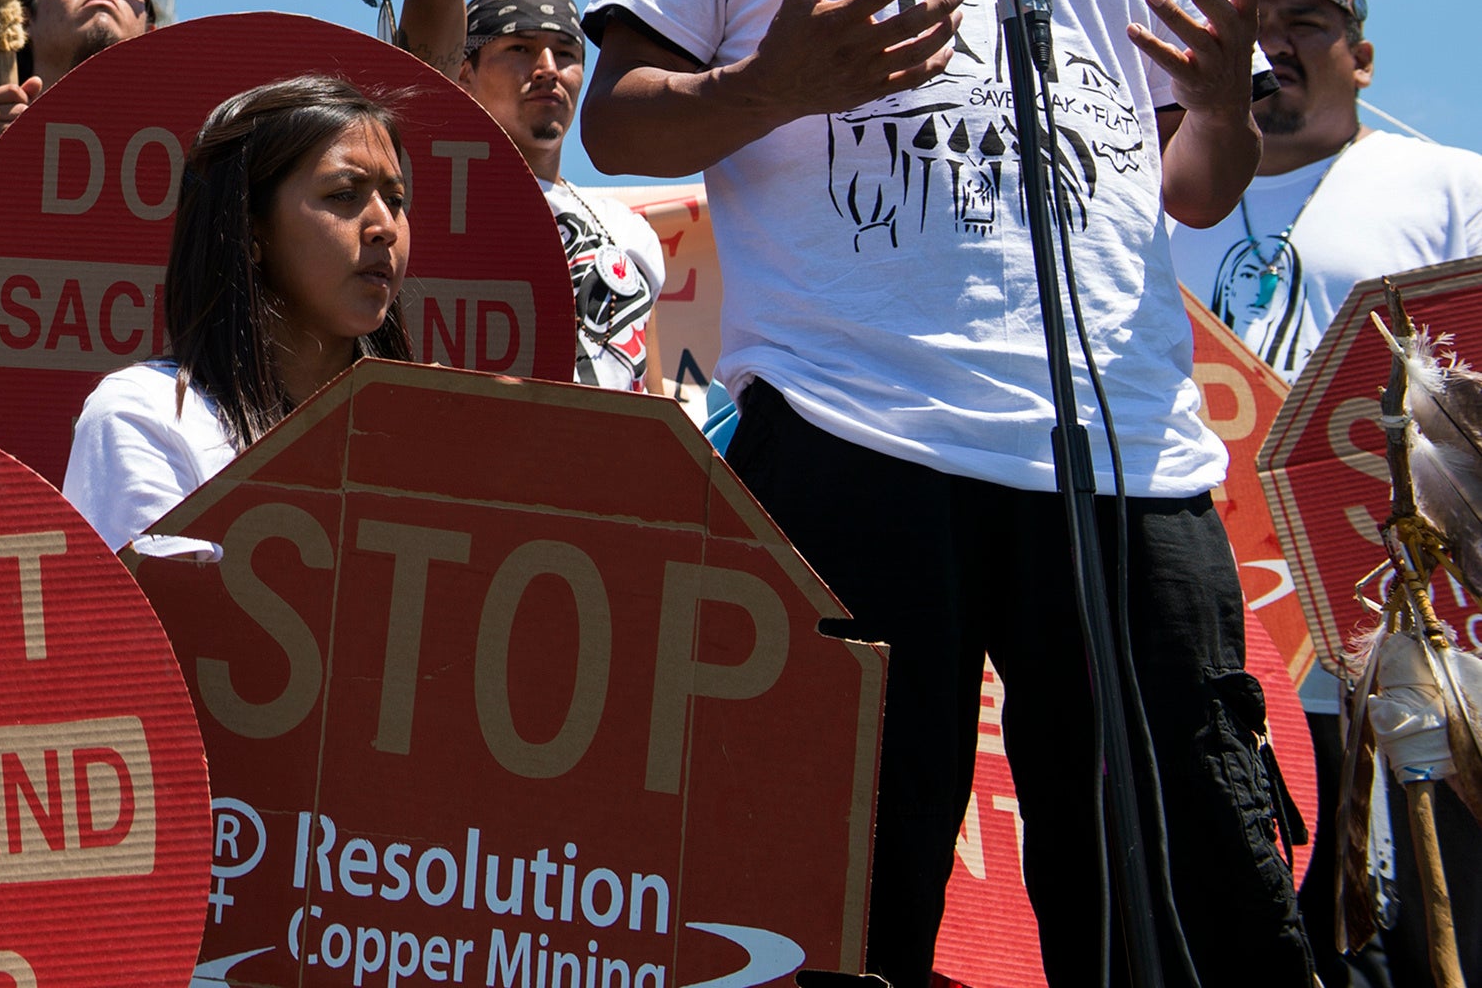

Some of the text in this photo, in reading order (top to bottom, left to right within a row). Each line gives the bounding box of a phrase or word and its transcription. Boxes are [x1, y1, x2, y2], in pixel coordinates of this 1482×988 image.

[969, 87, 1014, 109] SAVE
[1091, 103, 1135, 136] FLAT
[40, 122, 182, 222] DO
[196, 502, 791, 796] STOP
[292, 811, 671, 934] Resolution
[287, 905, 667, 988] Copper Mining
